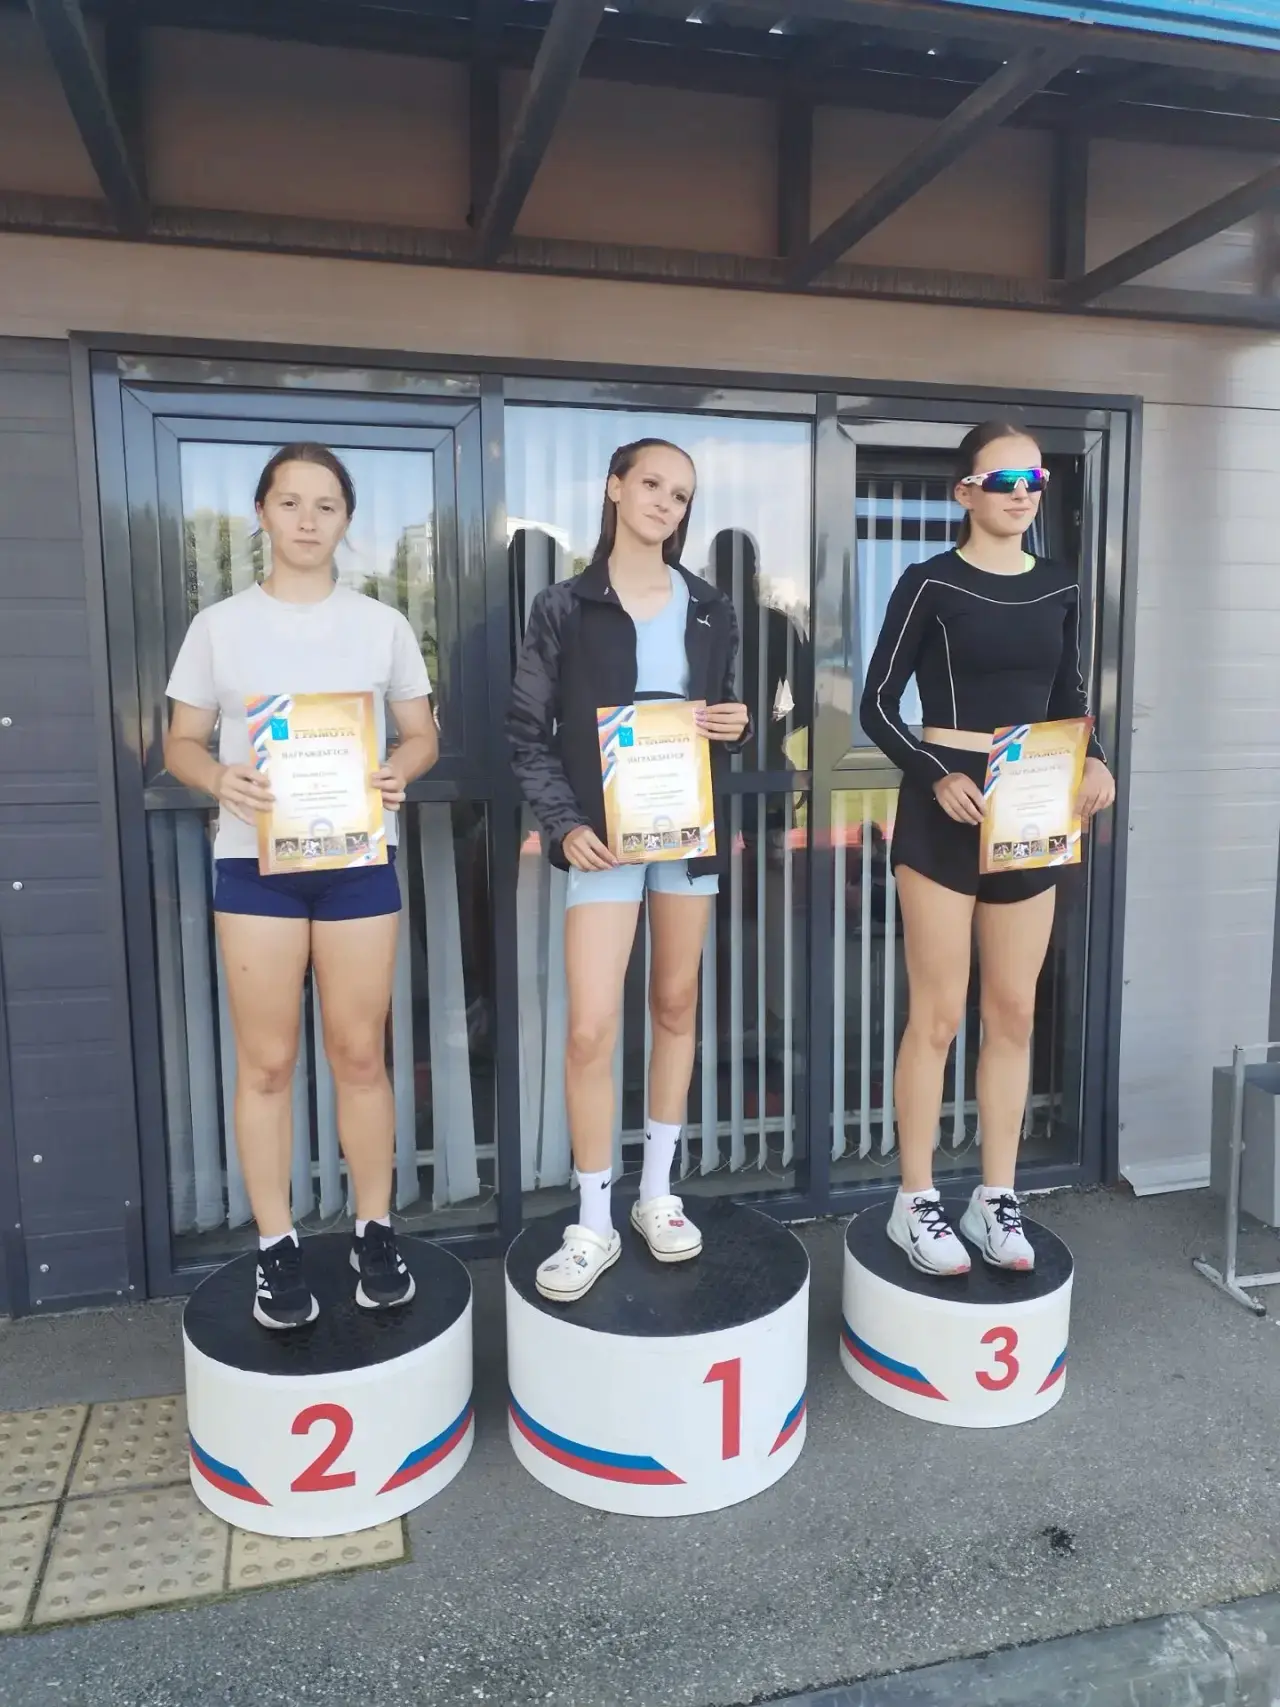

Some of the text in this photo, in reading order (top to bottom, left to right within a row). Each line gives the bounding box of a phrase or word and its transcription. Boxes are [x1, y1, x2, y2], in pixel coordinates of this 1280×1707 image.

[975, 1326, 1019, 1391] 3
[290, 1403, 356, 1492] 2
[703, 1357, 741, 1460] 1
